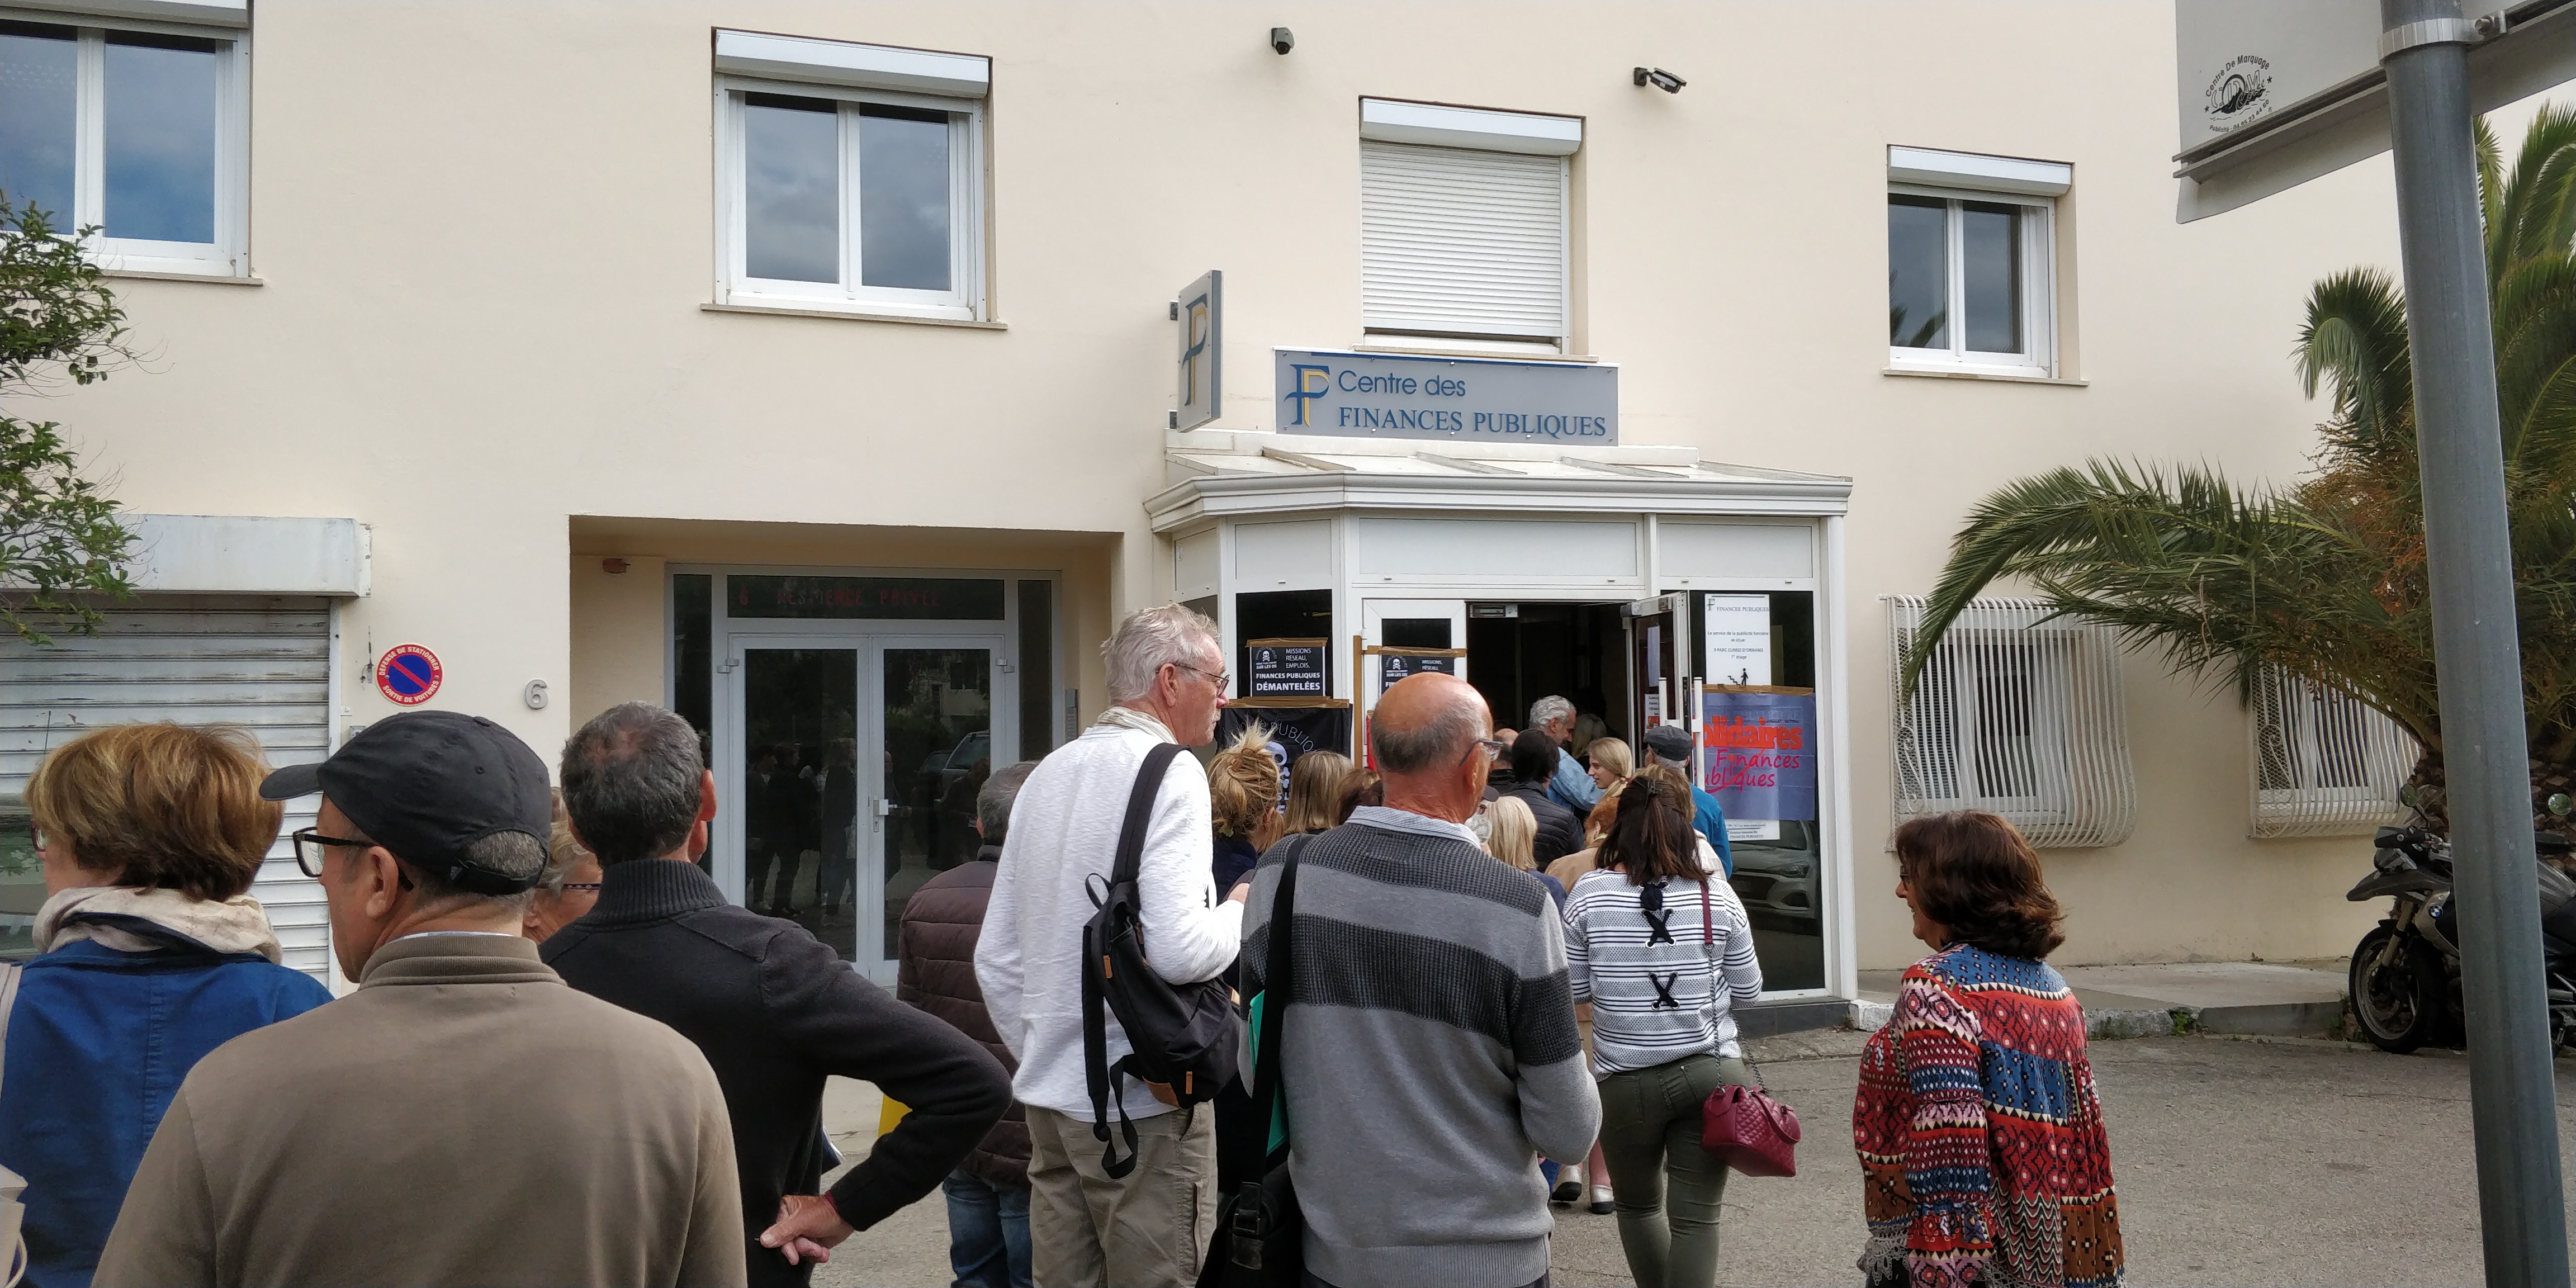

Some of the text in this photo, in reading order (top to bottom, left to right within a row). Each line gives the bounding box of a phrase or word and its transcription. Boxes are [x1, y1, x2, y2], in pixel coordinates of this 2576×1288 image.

[2205, 55, 2270, 97] Centre De Marquage
[2248, 114, 2255, 122] 23
[2263, 100, 2269, 108] 60
[1339, 370, 1466, 397] Centre des
[1339, 406, 1606, 439] FINANCES PUBLIQUES
[378, 651, 397, 675] DEFENSE
[408, 646, 439, 671] STATIONNER
[383, 685, 402, 702] SORTIE
[414, 680, 439, 702] VOITURES
[525, 679, 548, 710] 6
[1256, 681, 1320, 690] DÉMANTELÉES
[1271, 721, 1315, 754] PUBLIQ
[1703, 715, 1802, 750] olidaires
[1716, 749, 1800, 769] Finances
[1704, 764, 1775, 793] ubliques
